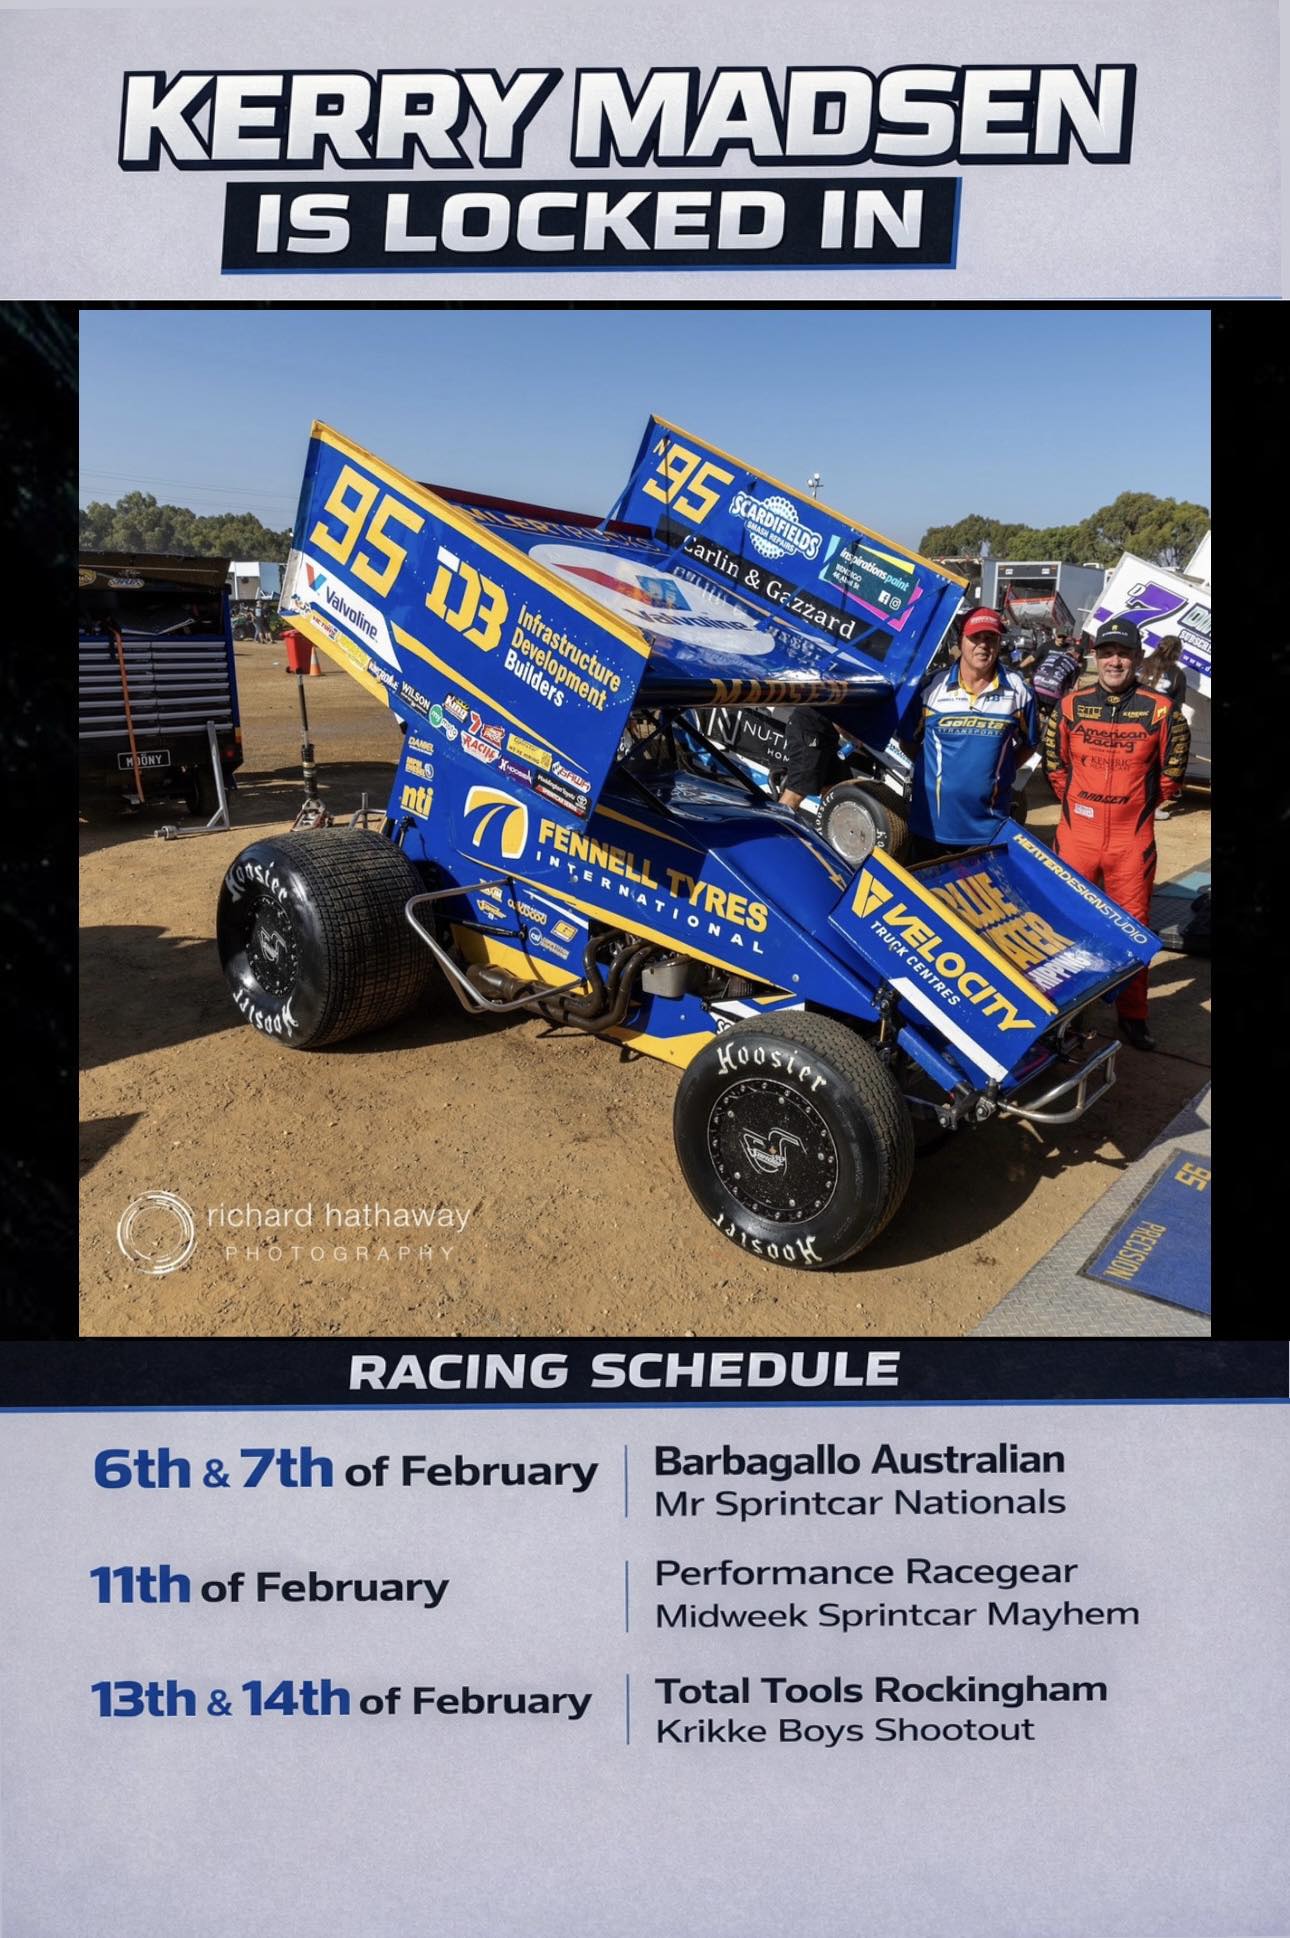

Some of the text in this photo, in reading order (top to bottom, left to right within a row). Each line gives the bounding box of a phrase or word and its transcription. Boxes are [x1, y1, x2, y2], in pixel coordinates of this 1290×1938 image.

[642, 443, 735, 525] 95
[309, 464, 426, 598] 95
[731, 493, 820, 558] SCARDIFIELDS
[746, 521, 796, 552] SMASH REPAIRS
[324, 585, 379, 641] Valvoline
[683, 534, 742, 578] Carlin
[744, 568, 761, 590] &
[766, 580, 856, 640] Gazzard
[503, 648, 566, 708] Builders
[510, 626, 608, 711] Development
[516, 604, 622, 693] Infrastructure
[401, 681, 431, 710] WILSON
[1075, 724, 1148, 740] American
[1083, 737, 1135, 753] Racing
[401, 785, 434, 818] nti
[1077, 790, 1131, 804] MADSEN
[225, 860, 289, 904] Hoosier
[536, 850, 764, 955] INTERNATIONAL
[538, 818, 769, 934] FENNELL TYRES
[1012, 833, 1148, 945] HEATERDESIGNSTUDIO
[870, 921, 961, 1006] TRUCK CENTRES
[882, 903, 1037, 1031] VELOCITY
[232, 987, 300, 1038] Hoosier
[717, 1041, 827, 1092] Hoosier
[713, 1212, 823, 1265] Hoosier
[1103, 1219, 1169, 1281] PRECISION
